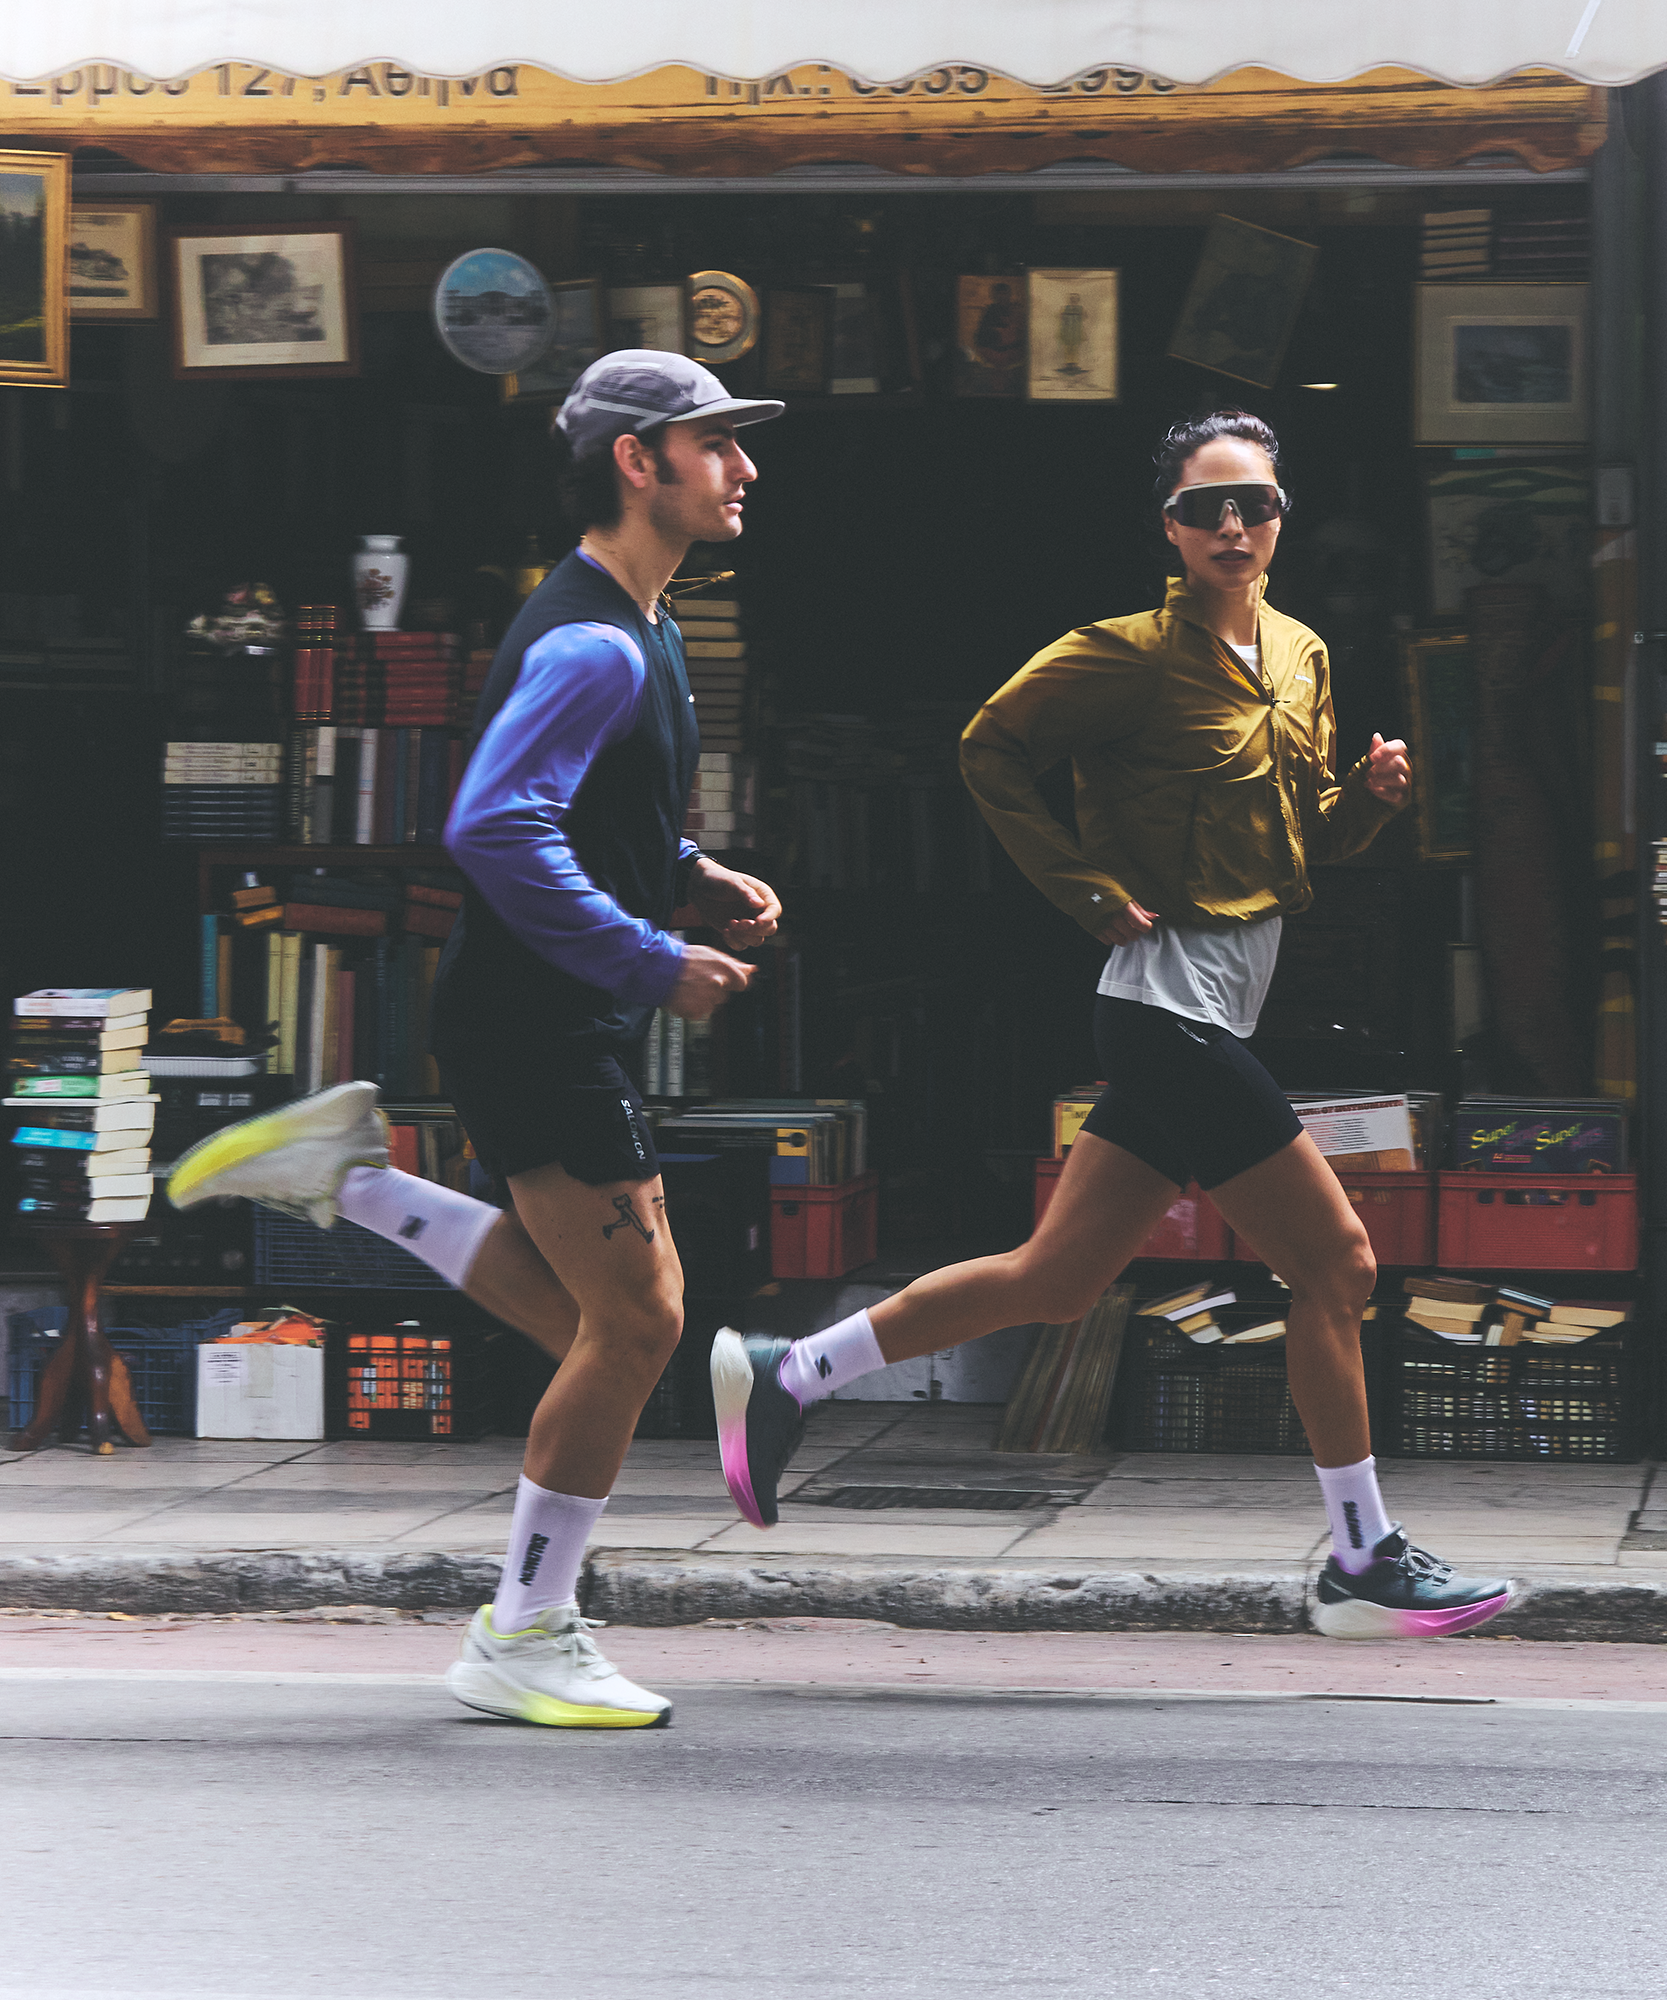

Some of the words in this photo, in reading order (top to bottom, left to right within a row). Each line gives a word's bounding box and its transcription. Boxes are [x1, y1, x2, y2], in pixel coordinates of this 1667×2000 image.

[620, 1099, 646, 1160] SALOMON
[1471, 1120, 1518, 1149] Super
[1535, 1121, 1583, 1150] Super
